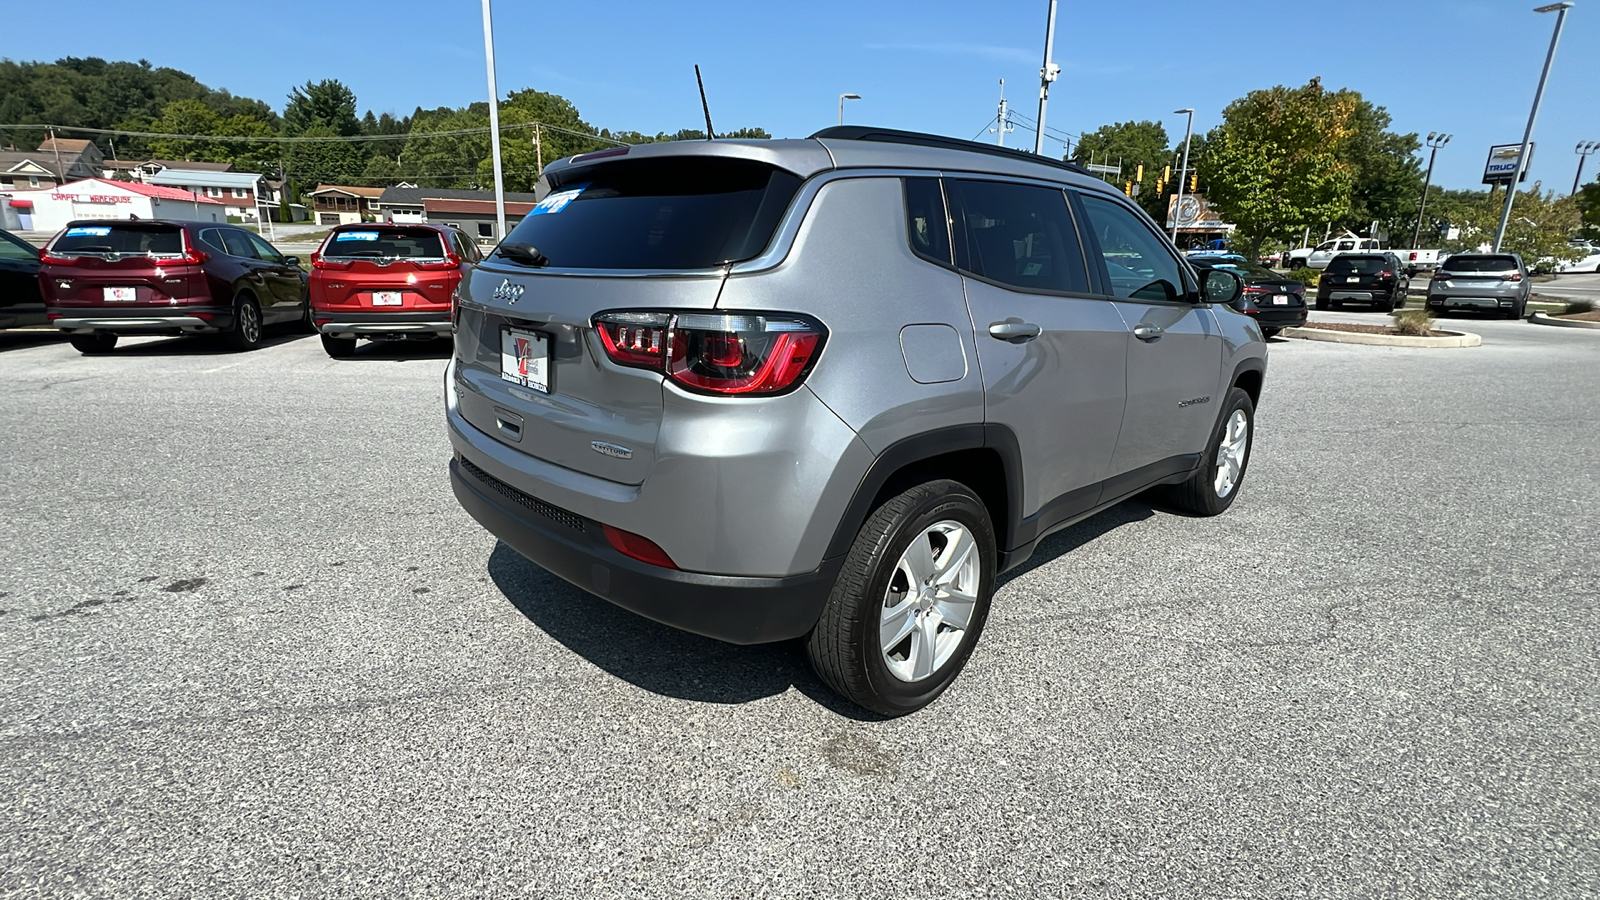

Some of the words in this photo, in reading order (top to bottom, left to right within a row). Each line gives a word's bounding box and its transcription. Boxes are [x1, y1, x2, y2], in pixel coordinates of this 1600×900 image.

[51, 193, 80, 202] CARPET
[89, 195, 132, 204] WAREHOUSE
[492, 278, 525, 306] Jeep
[593, 443, 630, 457] LATITUDE
